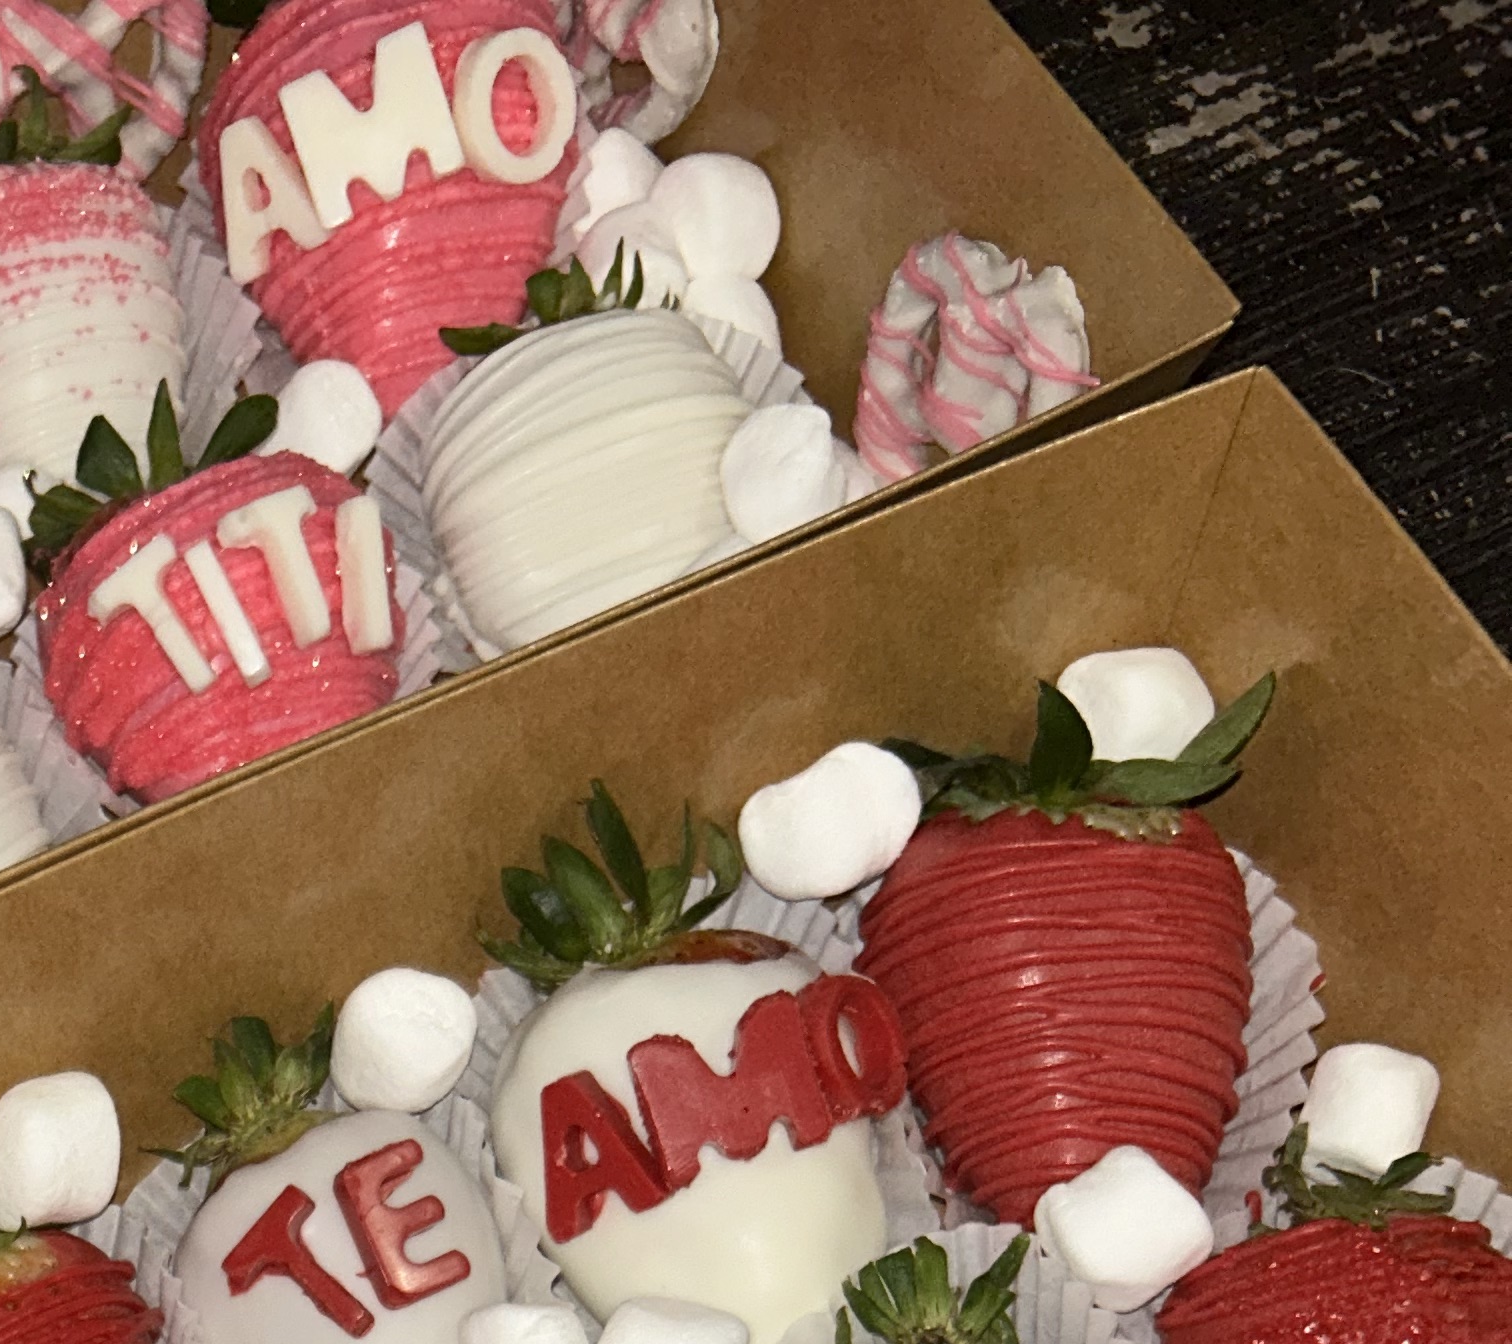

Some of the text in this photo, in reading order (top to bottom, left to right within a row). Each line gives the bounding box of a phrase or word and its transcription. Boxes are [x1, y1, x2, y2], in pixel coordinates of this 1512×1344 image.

[219, 21, 577, 285] AMO
[89, 485, 396, 694] TITI
[540, 974, 906, 1243] AMO
[222, 1139, 470, 1338] TE
